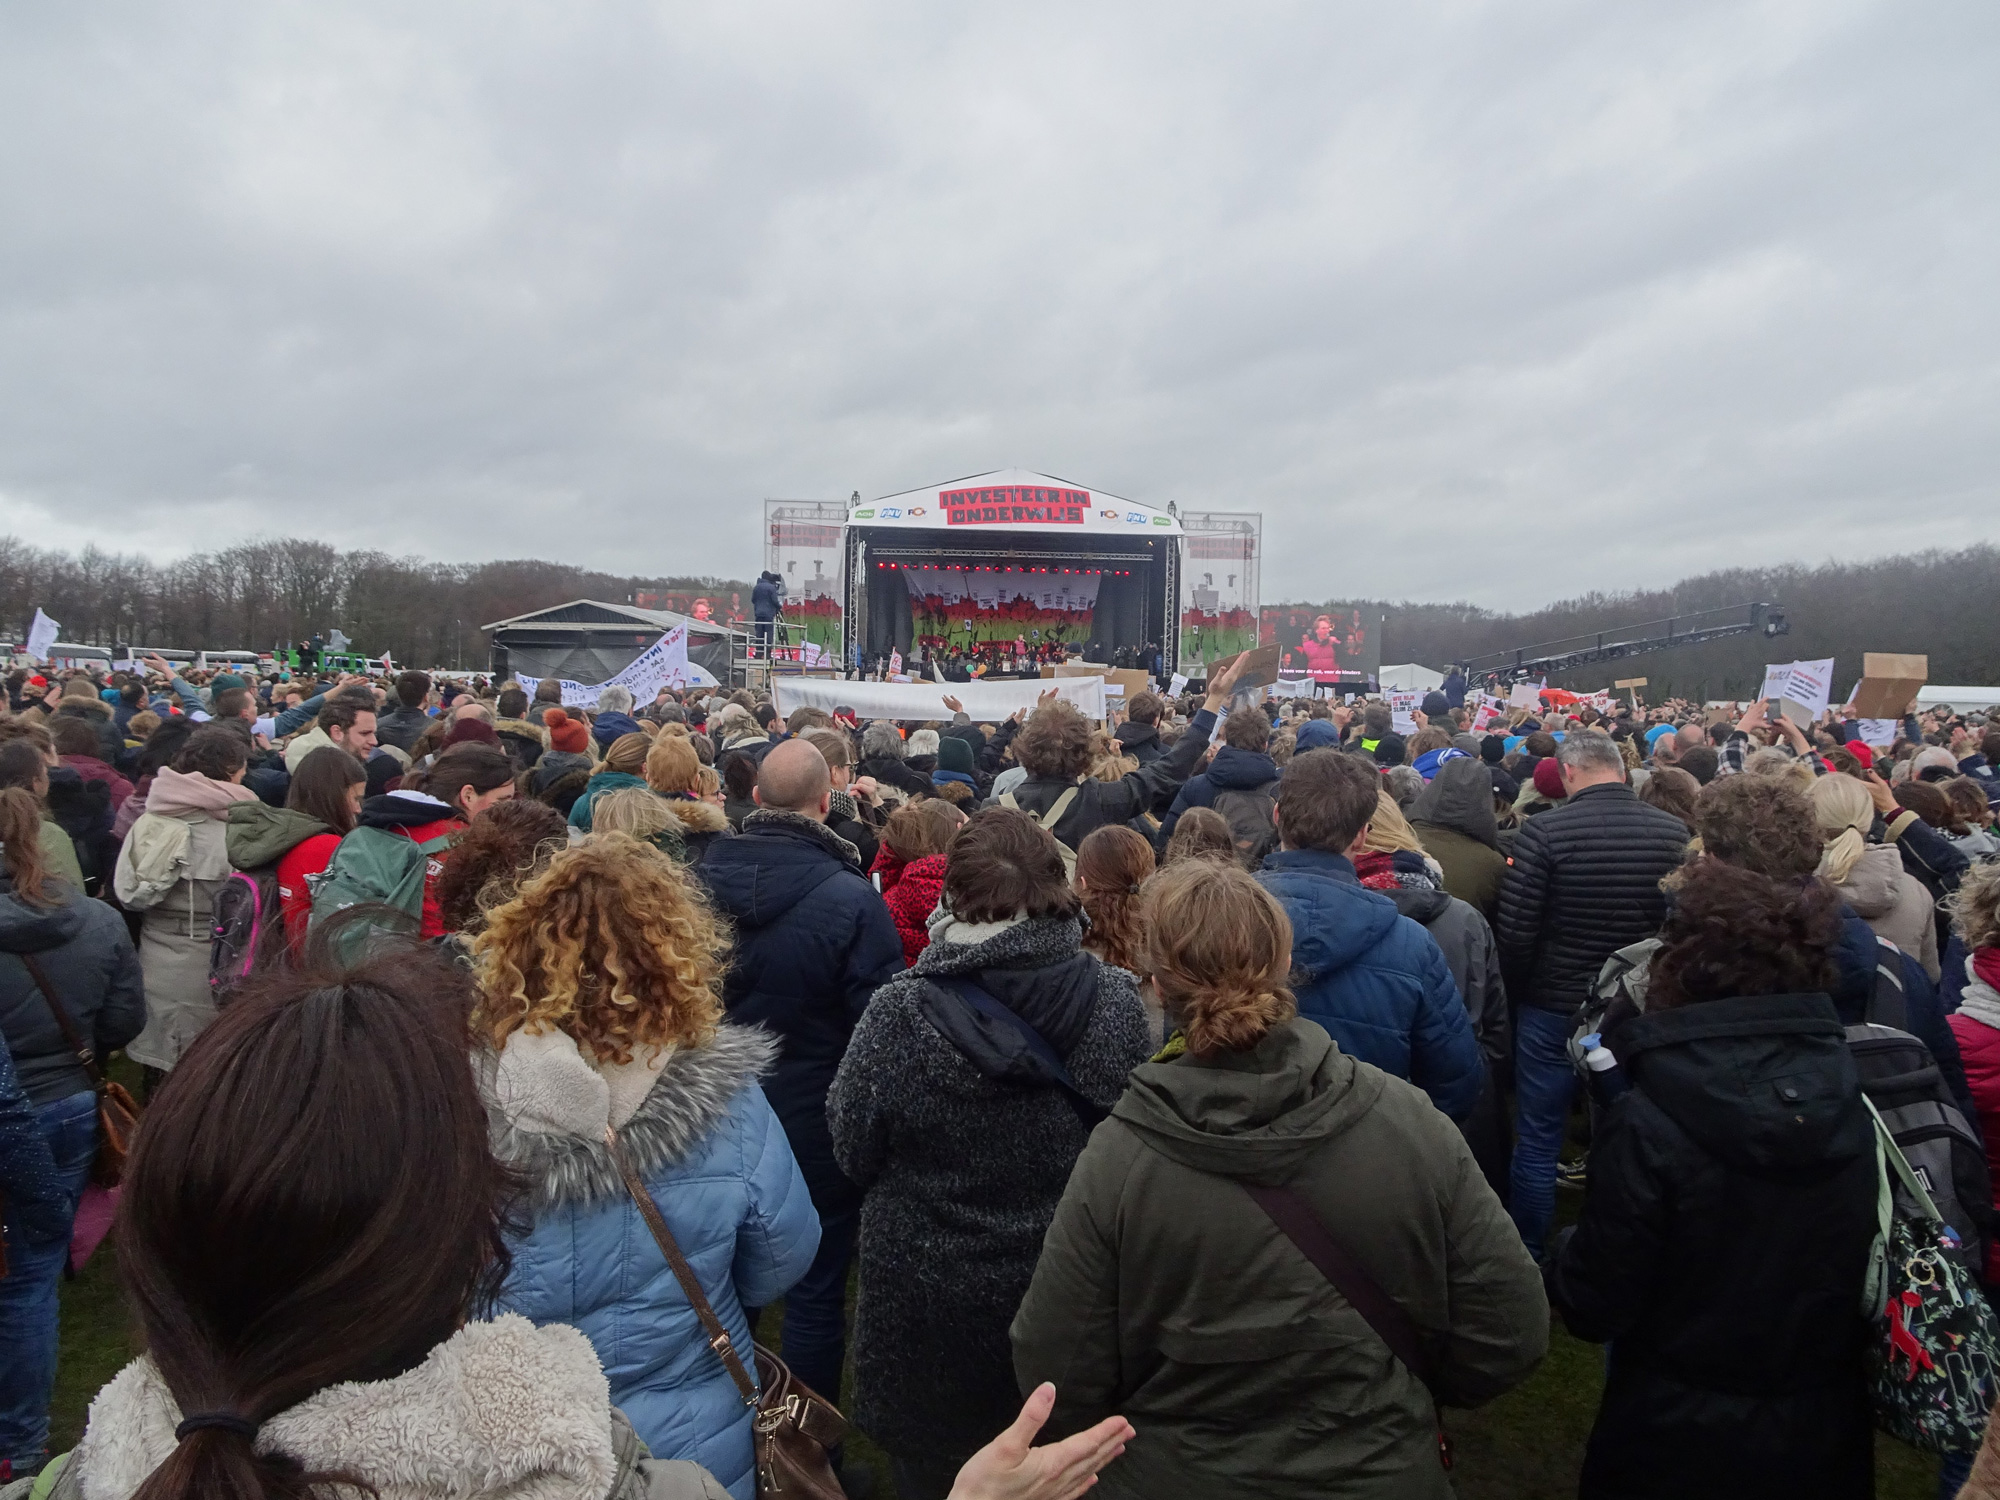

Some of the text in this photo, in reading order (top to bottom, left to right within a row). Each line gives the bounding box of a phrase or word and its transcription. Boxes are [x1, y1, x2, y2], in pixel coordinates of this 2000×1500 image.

[943, 488, 1087, 506] INVESTEER IN
[880, 507, 902, 518] FNV
[952, 506, 1080, 523] ONDERWIJS
